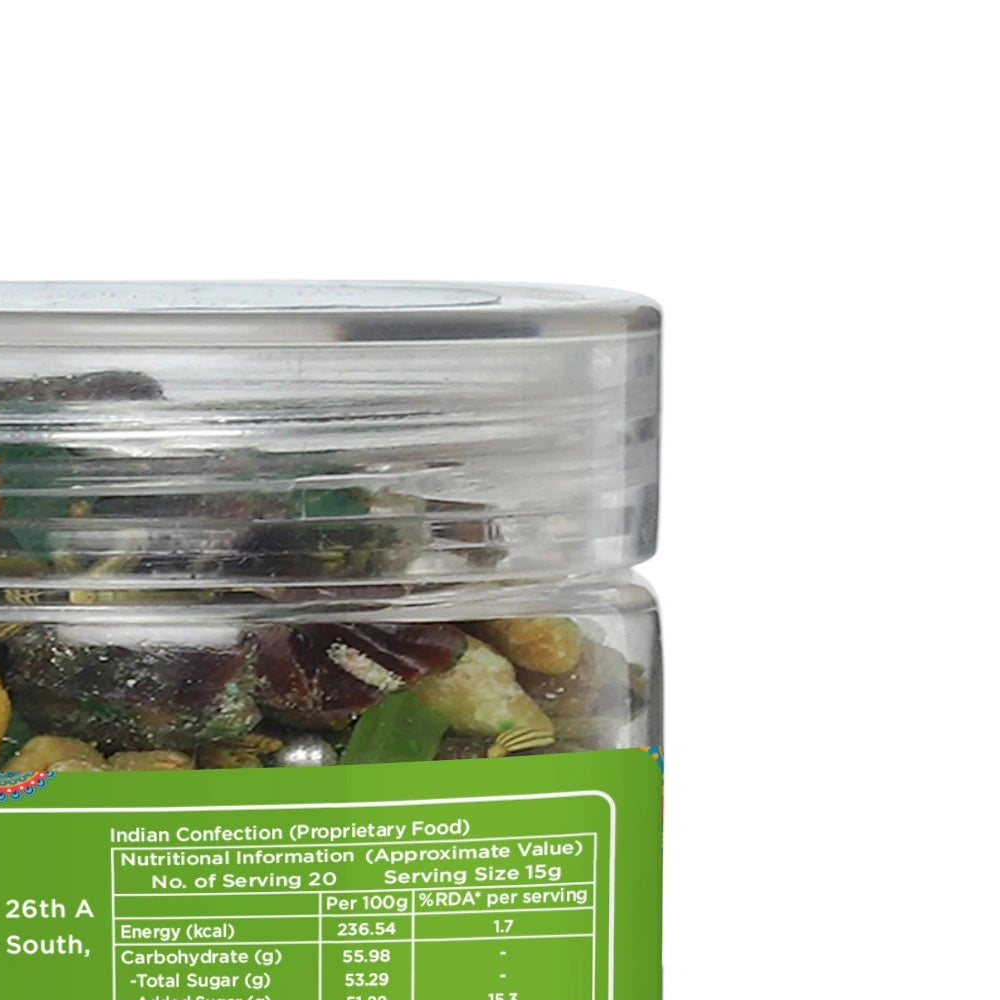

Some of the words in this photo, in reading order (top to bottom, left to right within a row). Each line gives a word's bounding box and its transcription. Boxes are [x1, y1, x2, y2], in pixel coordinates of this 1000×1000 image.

[111, 828, 169, 842] Indian
[176, 825, 282, 841] Confection
[290, 823, 406, 841] (Proprietary
[412, 819, 470, 836] Food)
[121, 851, 229, 866] Nutritional
[237, 849, 354, 864] Information
[366, 845, 510, 864] (Approximate
[518, 840, 583, 856] Value)
[152, 875, 186, 888] No.
[194, 874, 216, 888] of
[223, 873, 301, 889] Serving
[309, 872, 336, 886] 20
[384, 868, 467, 885] Serving
[475, 866, 519, 881] Size
[525, 864, 561, 881] 15g
[327, 896, 357, 910] Per
[363, 895, 408, 913] 100g
[487, 893, 518, 908] per
[523, 888, 587, 904] serving
[6, 899, 65, 918] 26th
[75, 899, 94, 918] A
[121, 925, 181, 941] Energy
[186, 923, 234, 940] (kcal)
[337, 922, 396, 936] 236.54
[494, 919, 513, 933] 1.7
[7, 934, 89, 957] South,
[121, 949, 248, 966] Carbohydrate
[255, 949, 282, 966] (g)
[343, 949, 390, 963] 55.98
[131, 973, 179, 987] -Total
[187, 973, 239, 990] Sugar
[245, 973, 270, 989] (g)
[345, 973, 389, 986] 53.29
